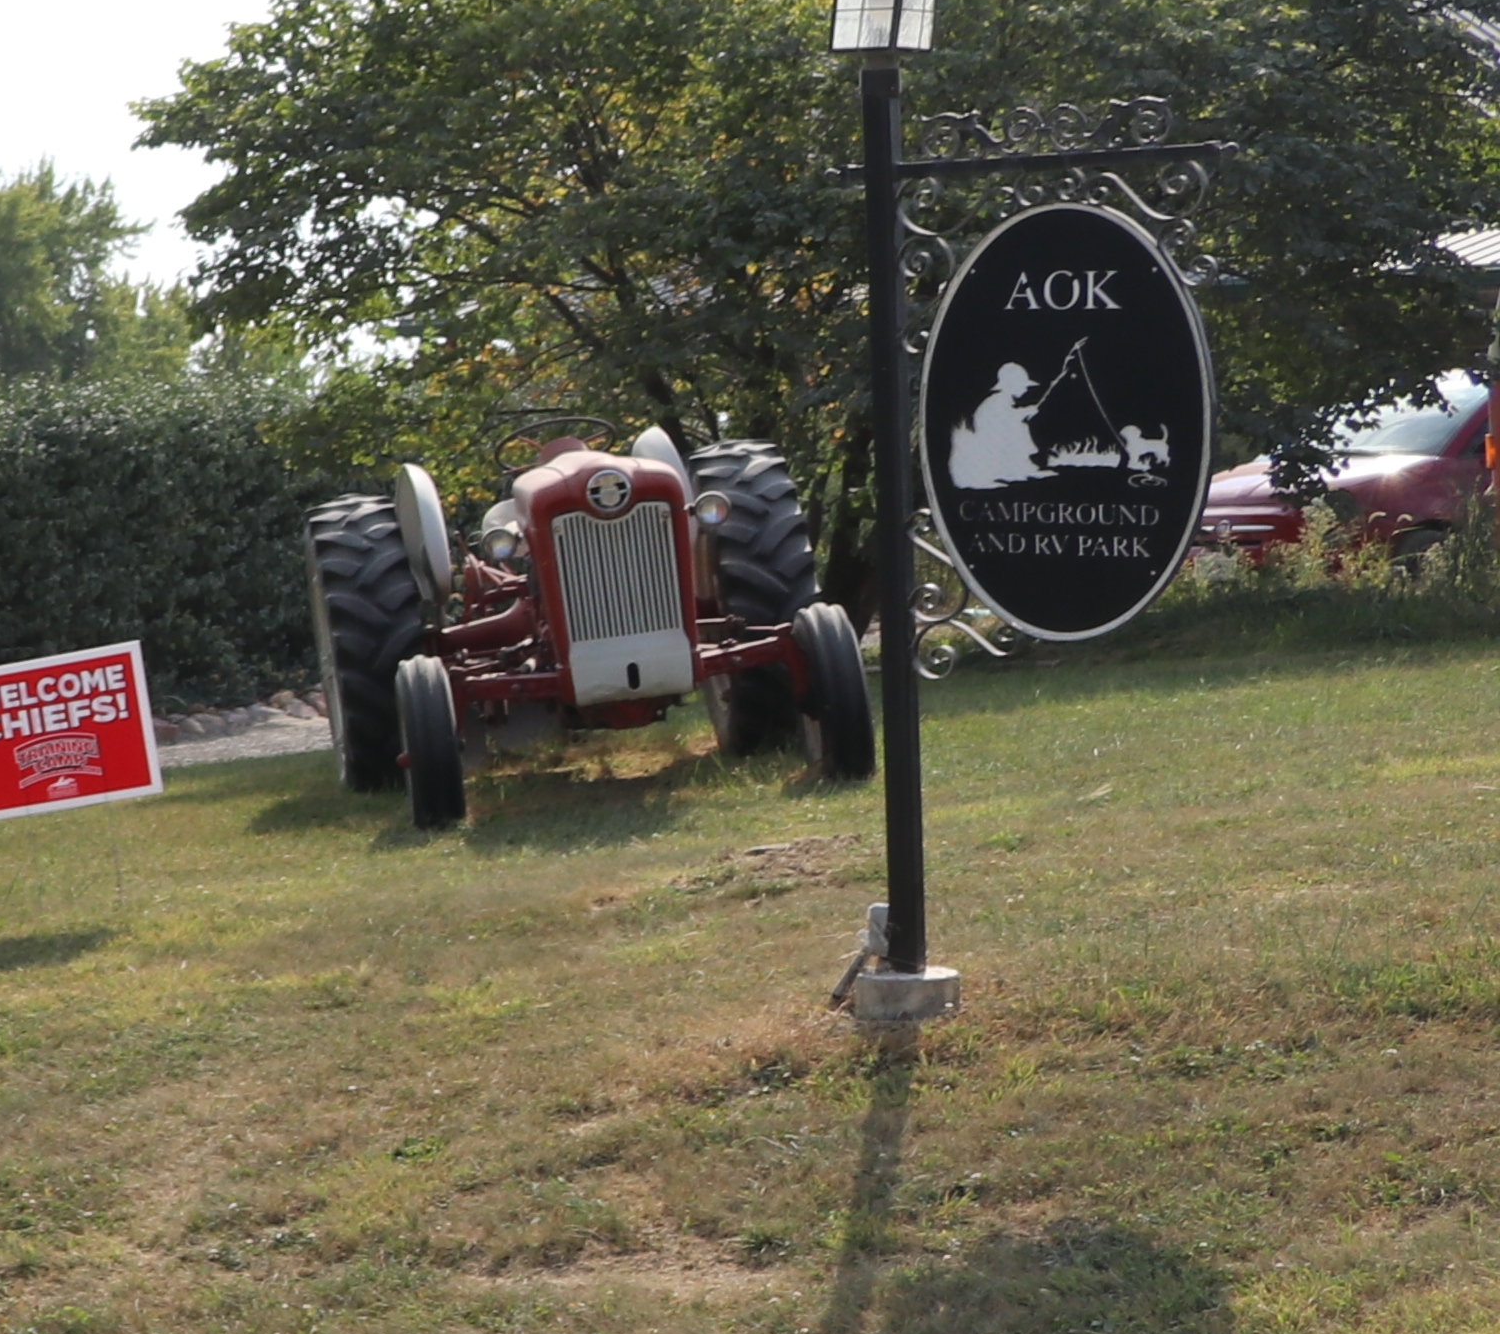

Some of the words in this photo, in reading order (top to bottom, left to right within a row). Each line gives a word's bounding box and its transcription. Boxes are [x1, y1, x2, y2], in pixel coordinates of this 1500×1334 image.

[1004, 269, 1122, 310] AOK
[959, 500, 1160, 526] CAMPGROUND
[969, 533, 1026, 554] AND
[1034, 534, 1069, 555] RV
[1077, 535, 1150, 558] PARK
[18, 740, 97, 765] TRAINING
[39, 754, 84, 770] CAMP
